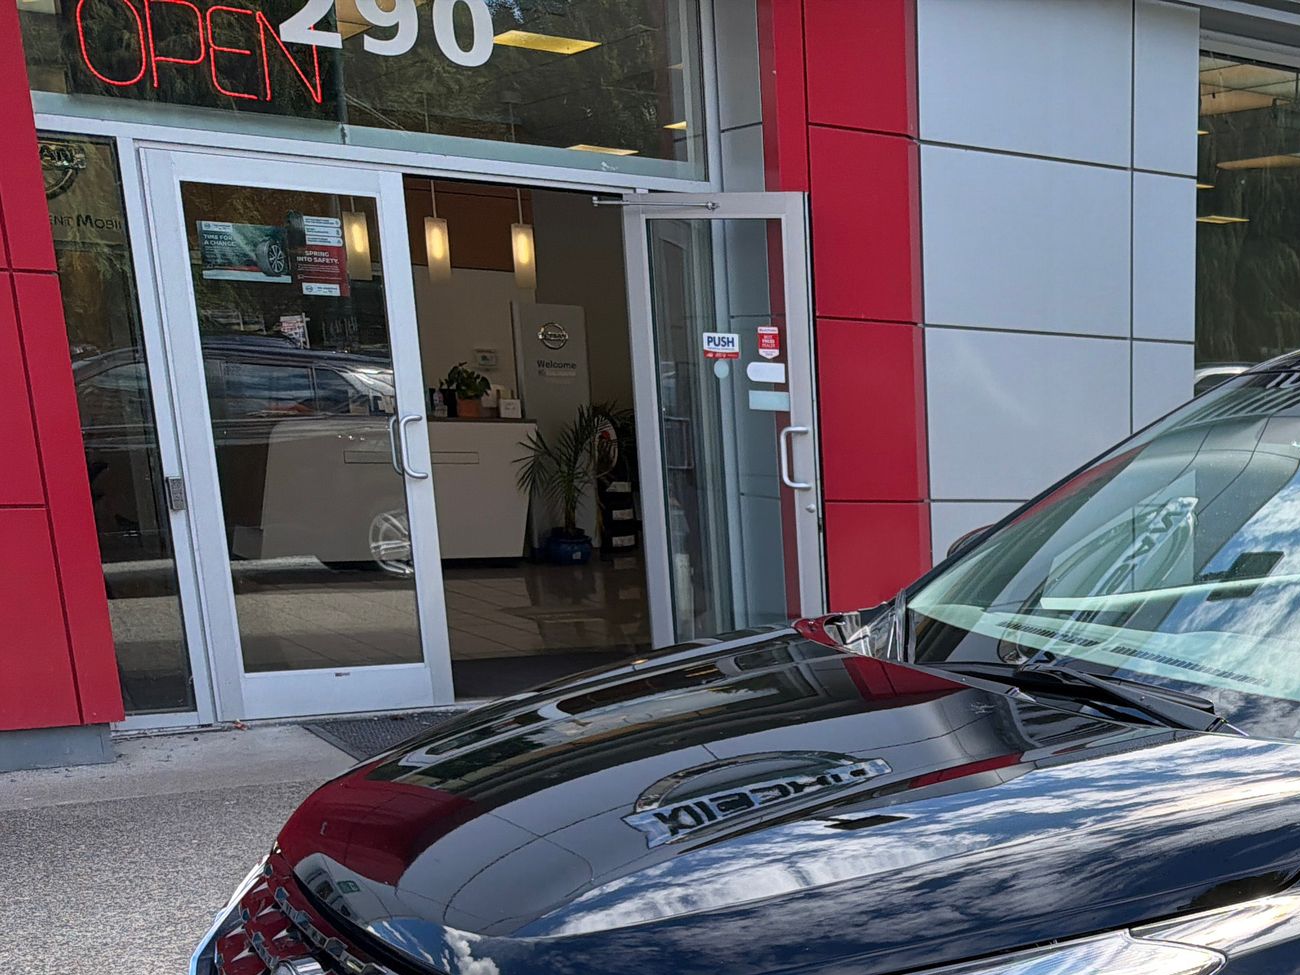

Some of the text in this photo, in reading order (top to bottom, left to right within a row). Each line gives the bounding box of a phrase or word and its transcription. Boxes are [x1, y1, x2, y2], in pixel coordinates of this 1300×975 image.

[76, 0, 322, 103] OPEN
[279, 0, 495, 67] 290
[707, 335, 735, 348] PUSH
[537, 360, 577, 370] Welcome
